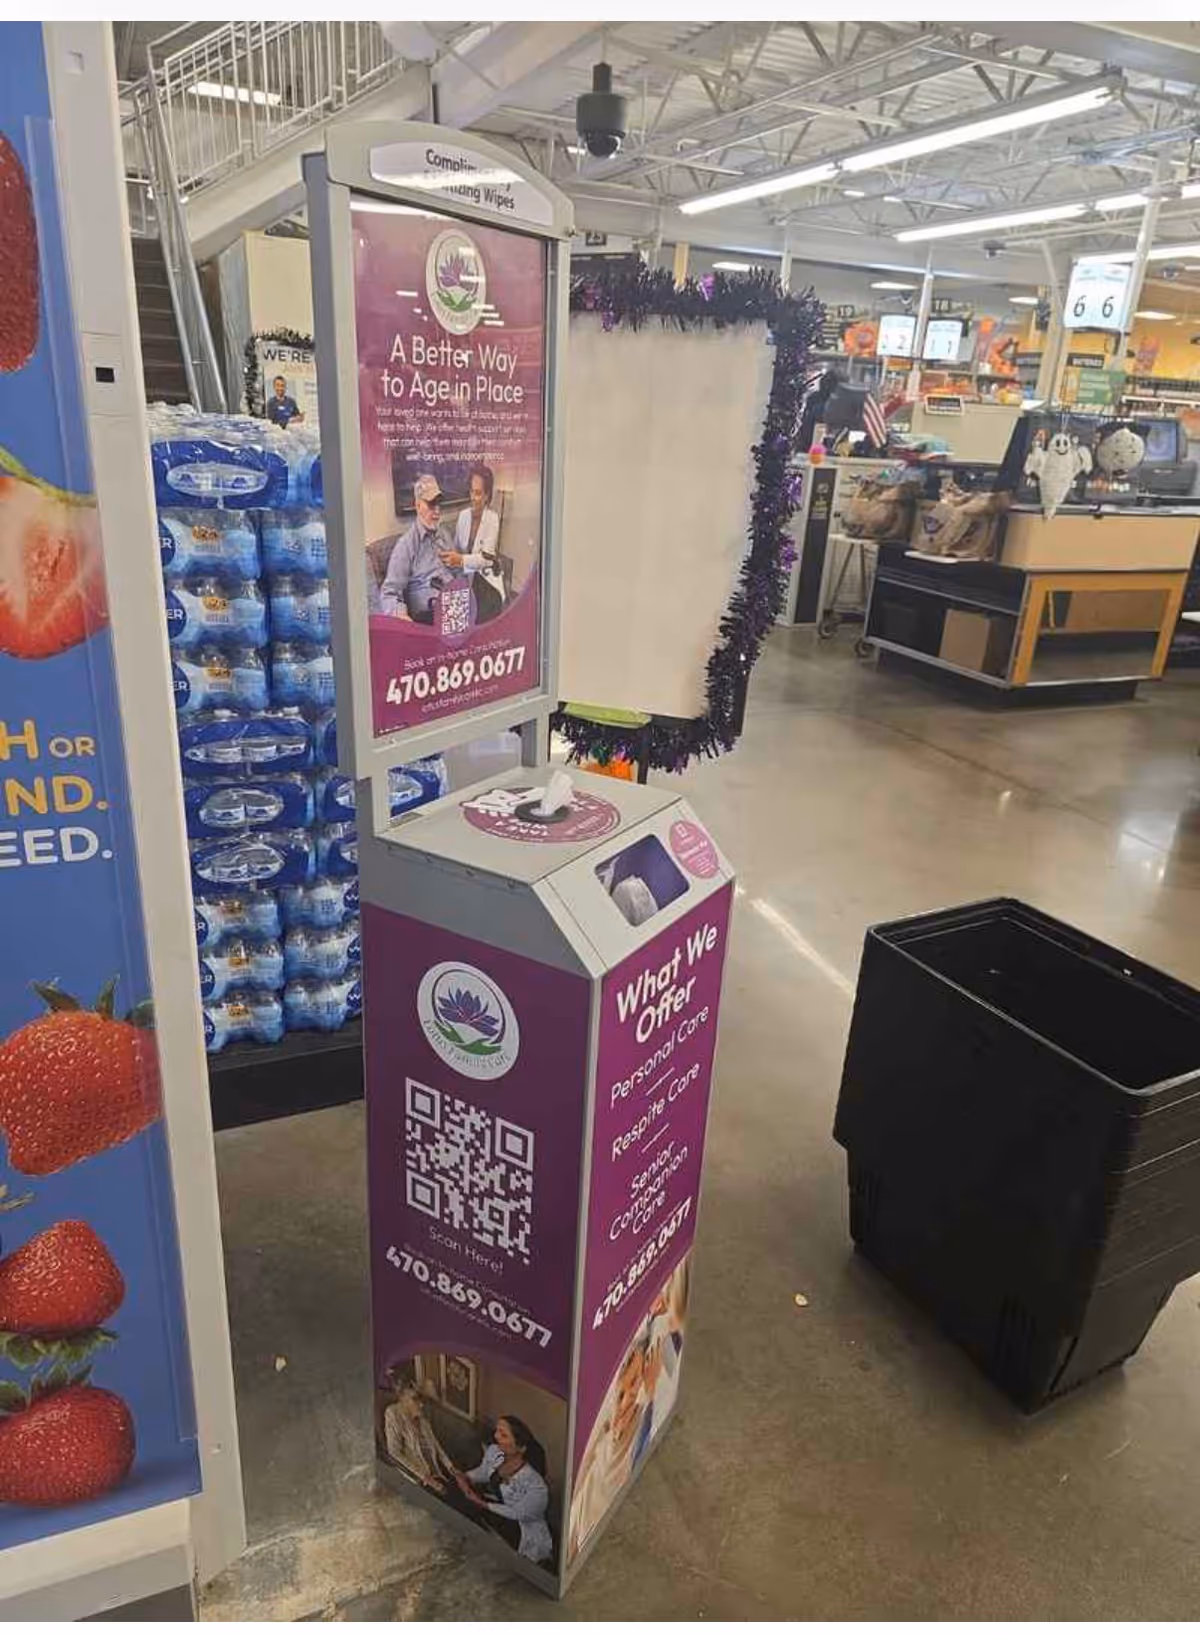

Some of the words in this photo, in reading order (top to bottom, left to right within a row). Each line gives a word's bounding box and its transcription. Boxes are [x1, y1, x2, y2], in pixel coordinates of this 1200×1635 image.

[484, 188, 515, 210] Wipes
[1074, 295, 1087, 318] 6
[1102, 296, 1114, 319] 6
[263, 349, 311, 363] WE'RE
[390, 333, 406, 363] A
[412, 335, 474, 369] Better
[478, 343, 518, 379] Way
[381, 368, 404, 398] to
[409, 371, 451, 407] Age
[455, 374, 471, 401] in
[476, 376, 524, 404] Place
[386, 646, 526, 705] 470.869.0677
[49, 736, 96, 758] OR
[5, 775, 108, 816] ND.
[616, 946, 682, 1024] What
[686, 923, 718, 967] We
[635, 975, 697, 1044] Offer
[610, 1030, 676, 1110] Personal
[677, 1005, 709, 1043] Care
[611, 1097, 666, 1162] Respite
[667, 1062, 701, 1102] Care
[609, 1146, 688, 1241] Companion
[630, 1140, 675, 1199] Senior
[632, 1190, 666, 1235] Care
[429, 1225, 462, 1252] Scan
[465, 1244, 504, 1276] Here!
[592, 1195, 692, 1331] 470.869.0677
[386, 1245, 553, 1348] 470.869.0677
